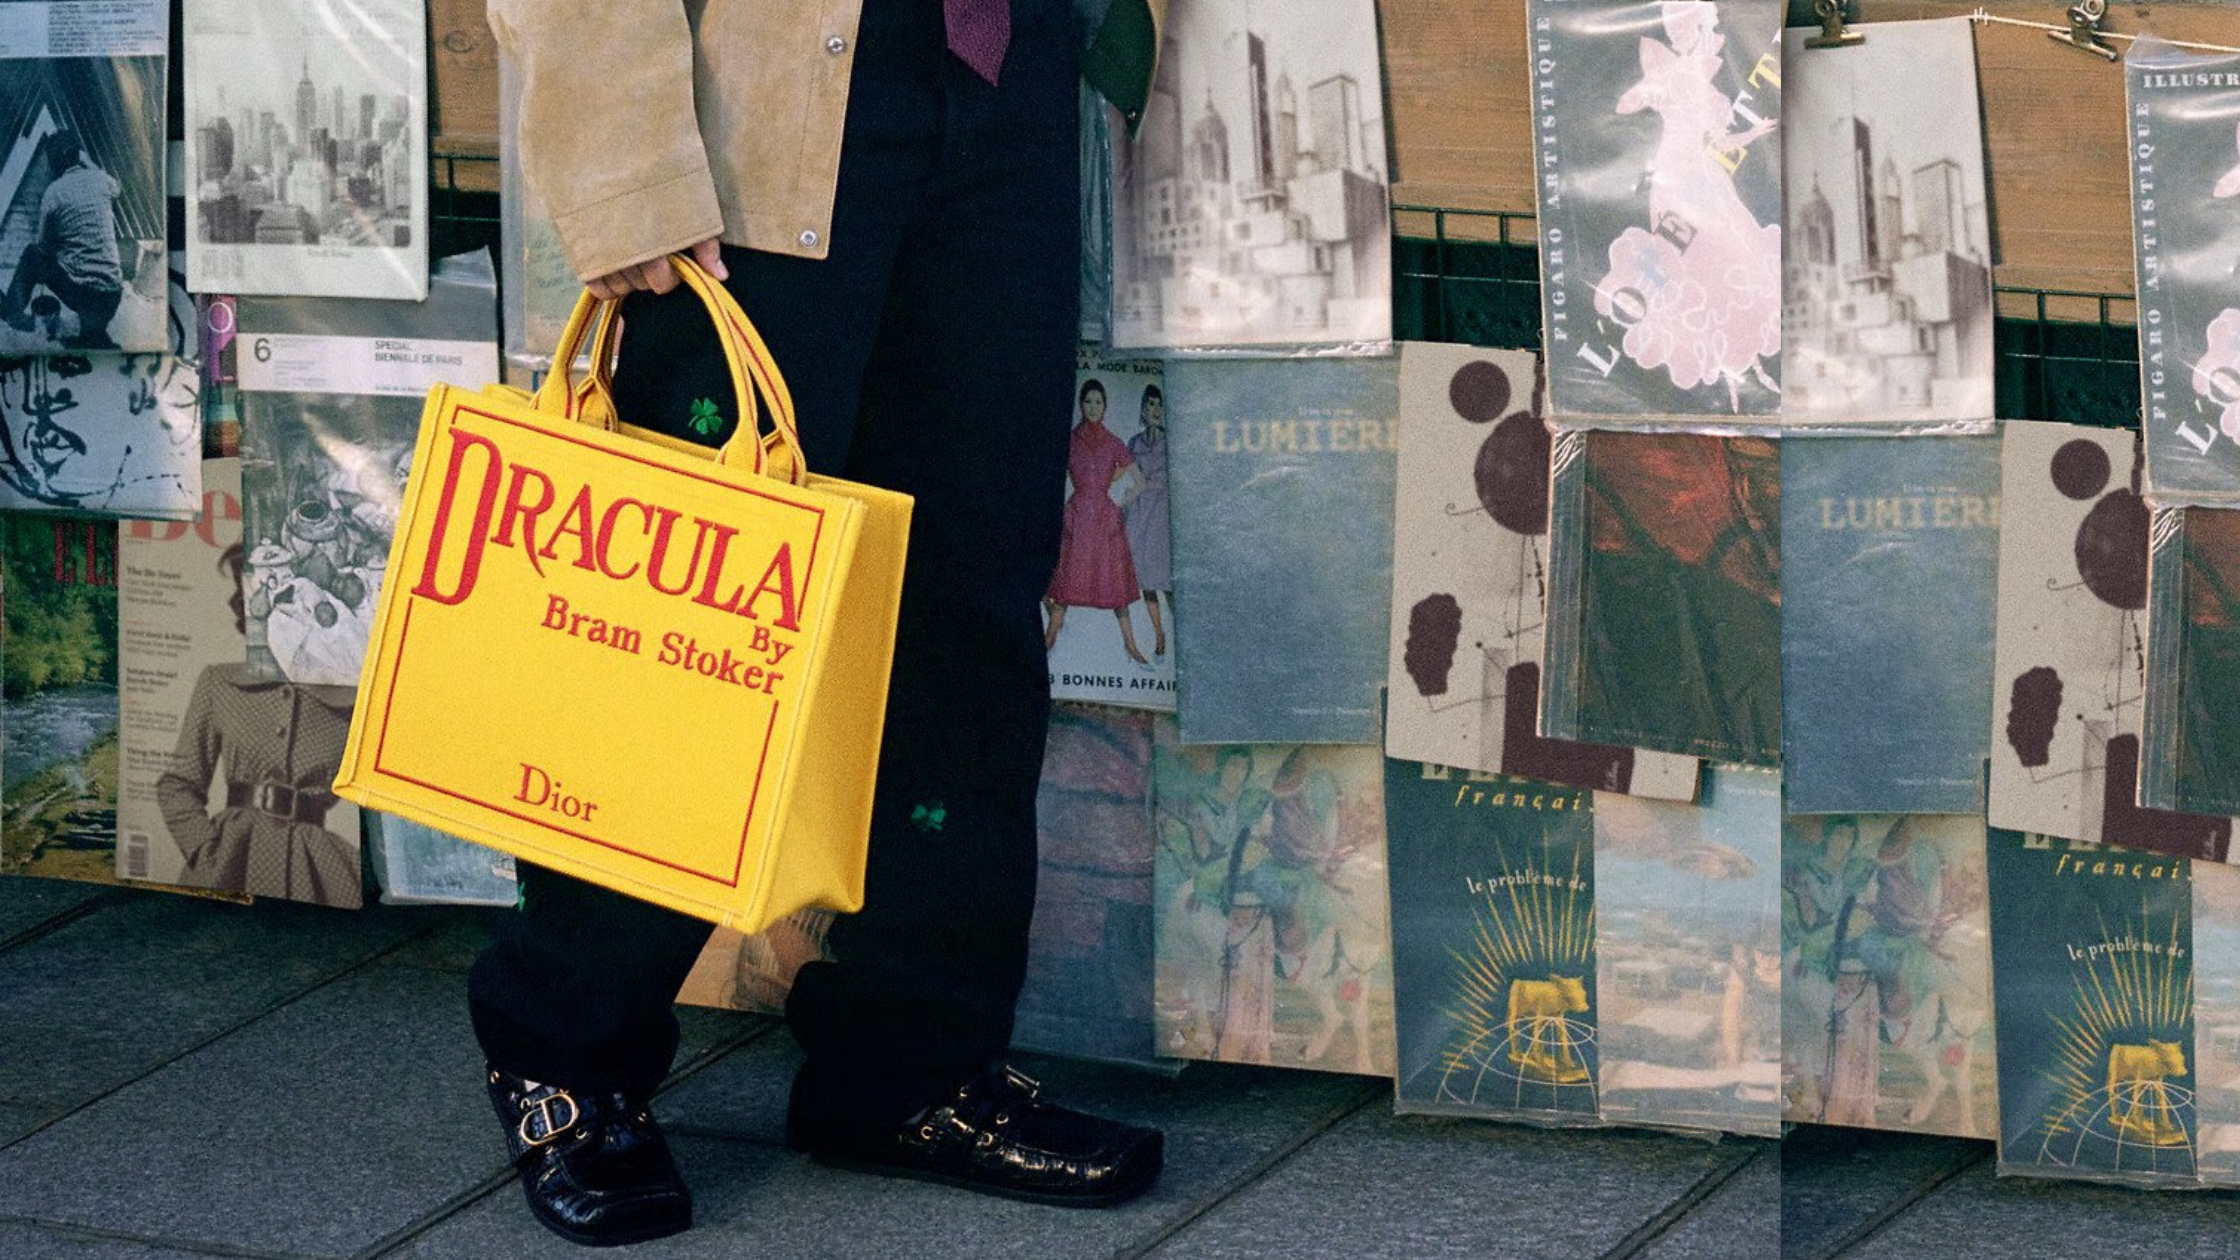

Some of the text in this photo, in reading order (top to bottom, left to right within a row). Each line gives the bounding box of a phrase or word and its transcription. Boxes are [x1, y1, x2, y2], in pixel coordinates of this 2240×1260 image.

[2143, 72, 2240, 88] ILLUSTR
[1536, 17, 1568, 341] FIGARO ARTISTIQUE
[2135, 103, 2167, 420] FIGARO ARTISTIQUE
[254, 338, 271, 362] 6
[375, 352, 463, 366] BIENNALE DE PARIS
[1097, 362, 1127, 373] MODE
[411, 427, 800, 632] DRACULA
[541, 593, 784, 696] Bram Stoker
[750, 625, 794, 666] By
[1062, 674, 1123, 689] BONNES
[514, 761, 598, 824] Dior
[1454, 785, 1594, 812] françai
[2055, 854, 2193, 881] françai
[1466, 876, 1484, 895] le
[1569, 873, 1587, 892] de
[2067, 944, 2085, 961] le
[2168, 940, 2185, 959] de
